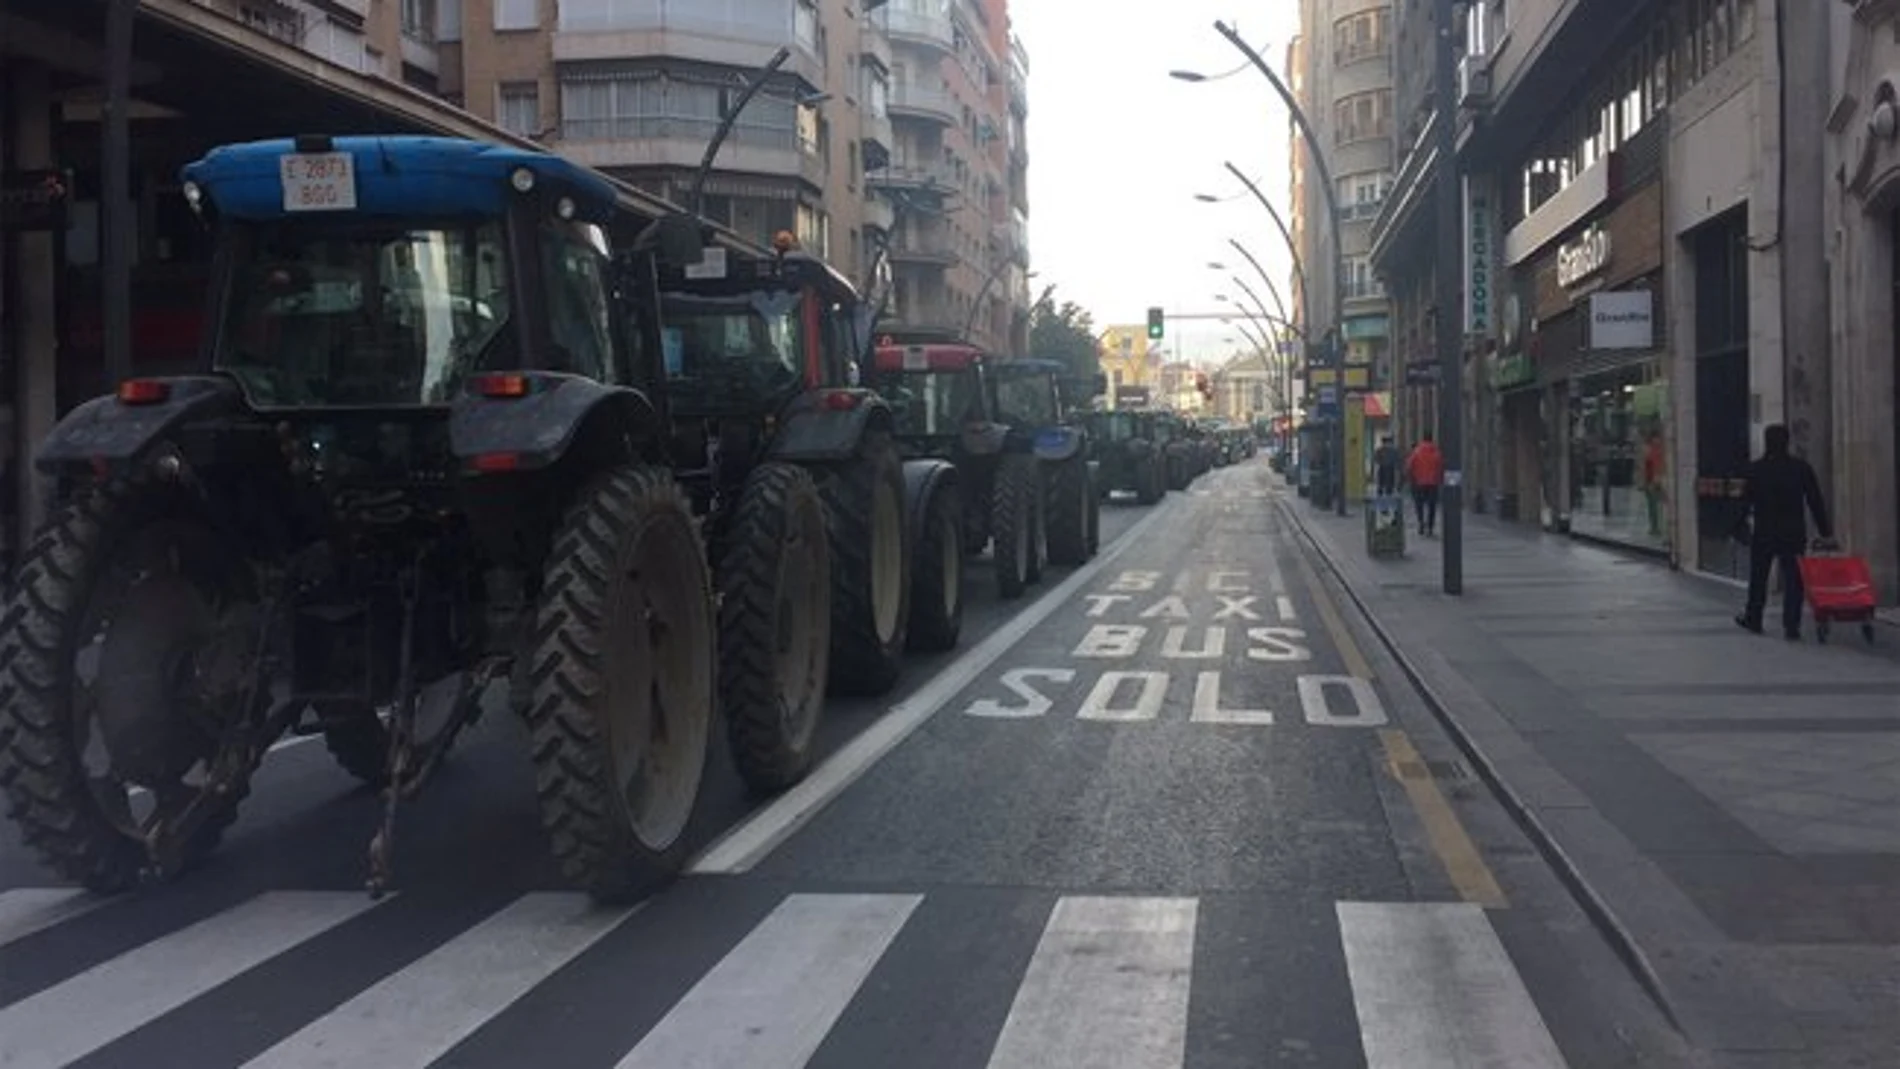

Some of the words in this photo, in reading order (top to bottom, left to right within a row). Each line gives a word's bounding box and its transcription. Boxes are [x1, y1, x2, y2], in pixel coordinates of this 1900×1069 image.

[1084, 594, 1296, 621] TAXI
[1071, 623, 1312, 661] BUS
[963, 667, 1389, 726] SOLO
